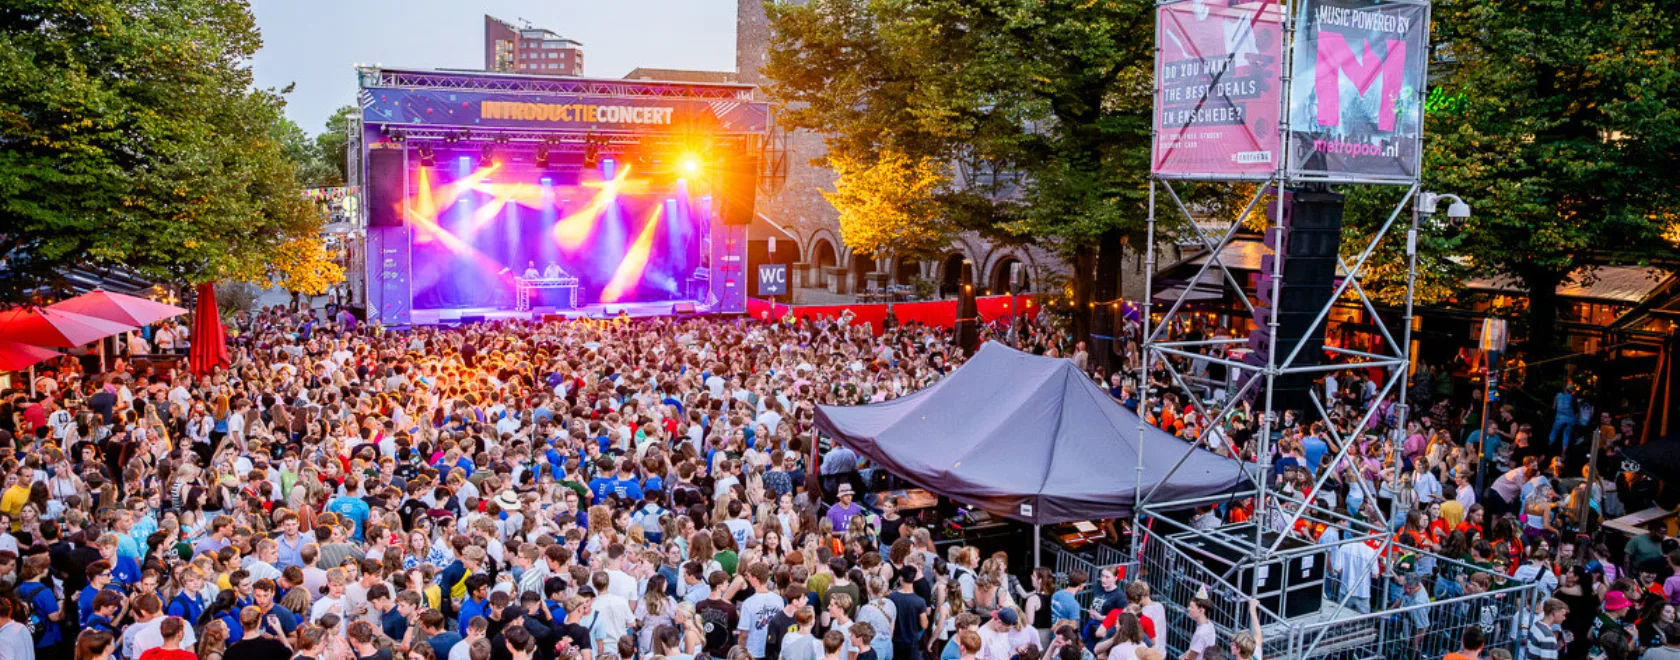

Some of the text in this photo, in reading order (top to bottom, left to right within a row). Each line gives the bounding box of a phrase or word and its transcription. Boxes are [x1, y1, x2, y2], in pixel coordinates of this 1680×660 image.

[1320, 5, 1410, 33] MUSIC POWERED BY
[1165, 59, 1230, 79] DO YOU WANT
[1164, 80, 1256, 101] THE BEST DEALS
[1315, 31, 1406, 131] M
[481, 101, 674, 124] INTRODUCTIECONCERT
[1163, 107, 1242, 125] IN ENSCHEDE?
[1313, 139, 1398, 158] metropool.nl
[760, 267, 785, 284] WC
